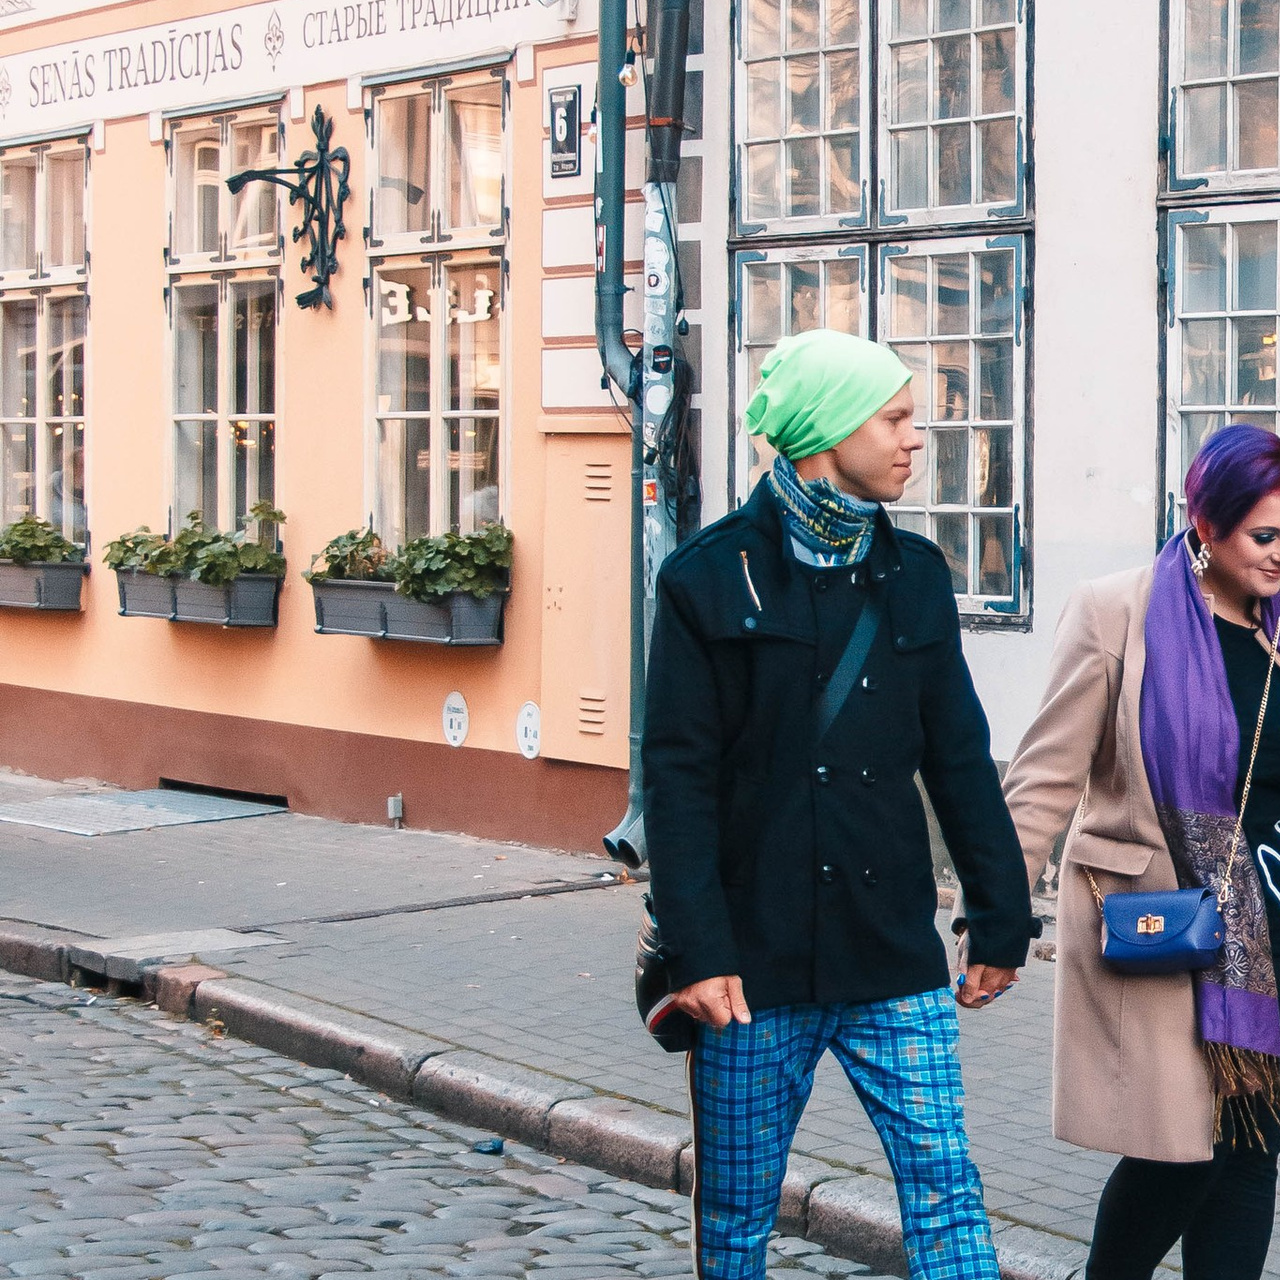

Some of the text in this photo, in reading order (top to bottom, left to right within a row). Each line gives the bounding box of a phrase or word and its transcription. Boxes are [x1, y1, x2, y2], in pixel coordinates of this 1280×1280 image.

[29, 23, 243, 108] SENĀS TRADĪCIJAS
[555, 107, 567, 142] 6
